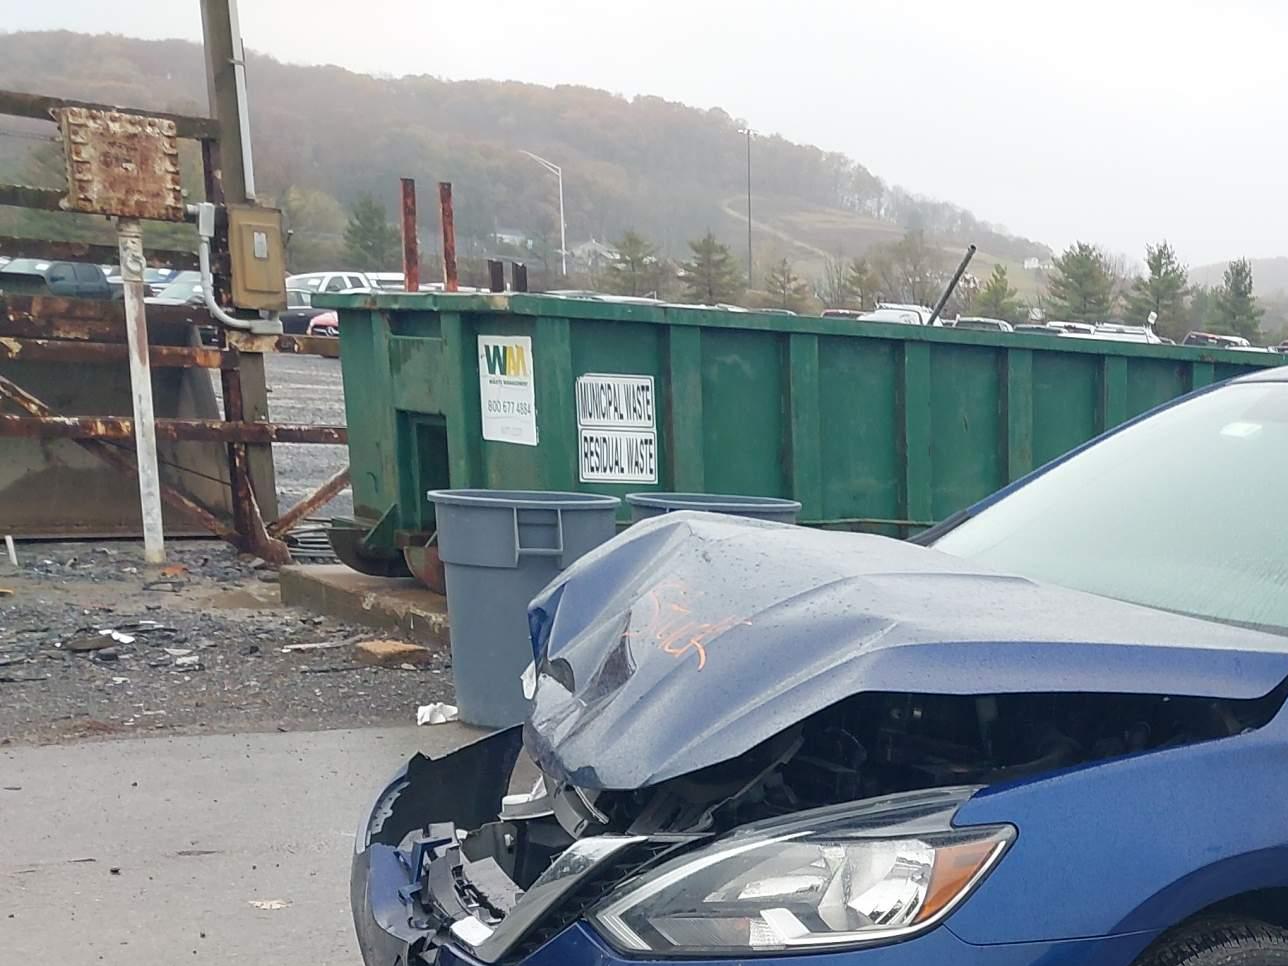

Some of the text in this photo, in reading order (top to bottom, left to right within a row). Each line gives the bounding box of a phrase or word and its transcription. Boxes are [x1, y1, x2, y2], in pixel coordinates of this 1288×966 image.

[484, 344, 528, 376] WM
[487, 399, 502, 414] 800
[580, 382, 651, 421] MUNICIPAL WASTE
[583, 436, 654, 474] RESIDUAL WASTE
